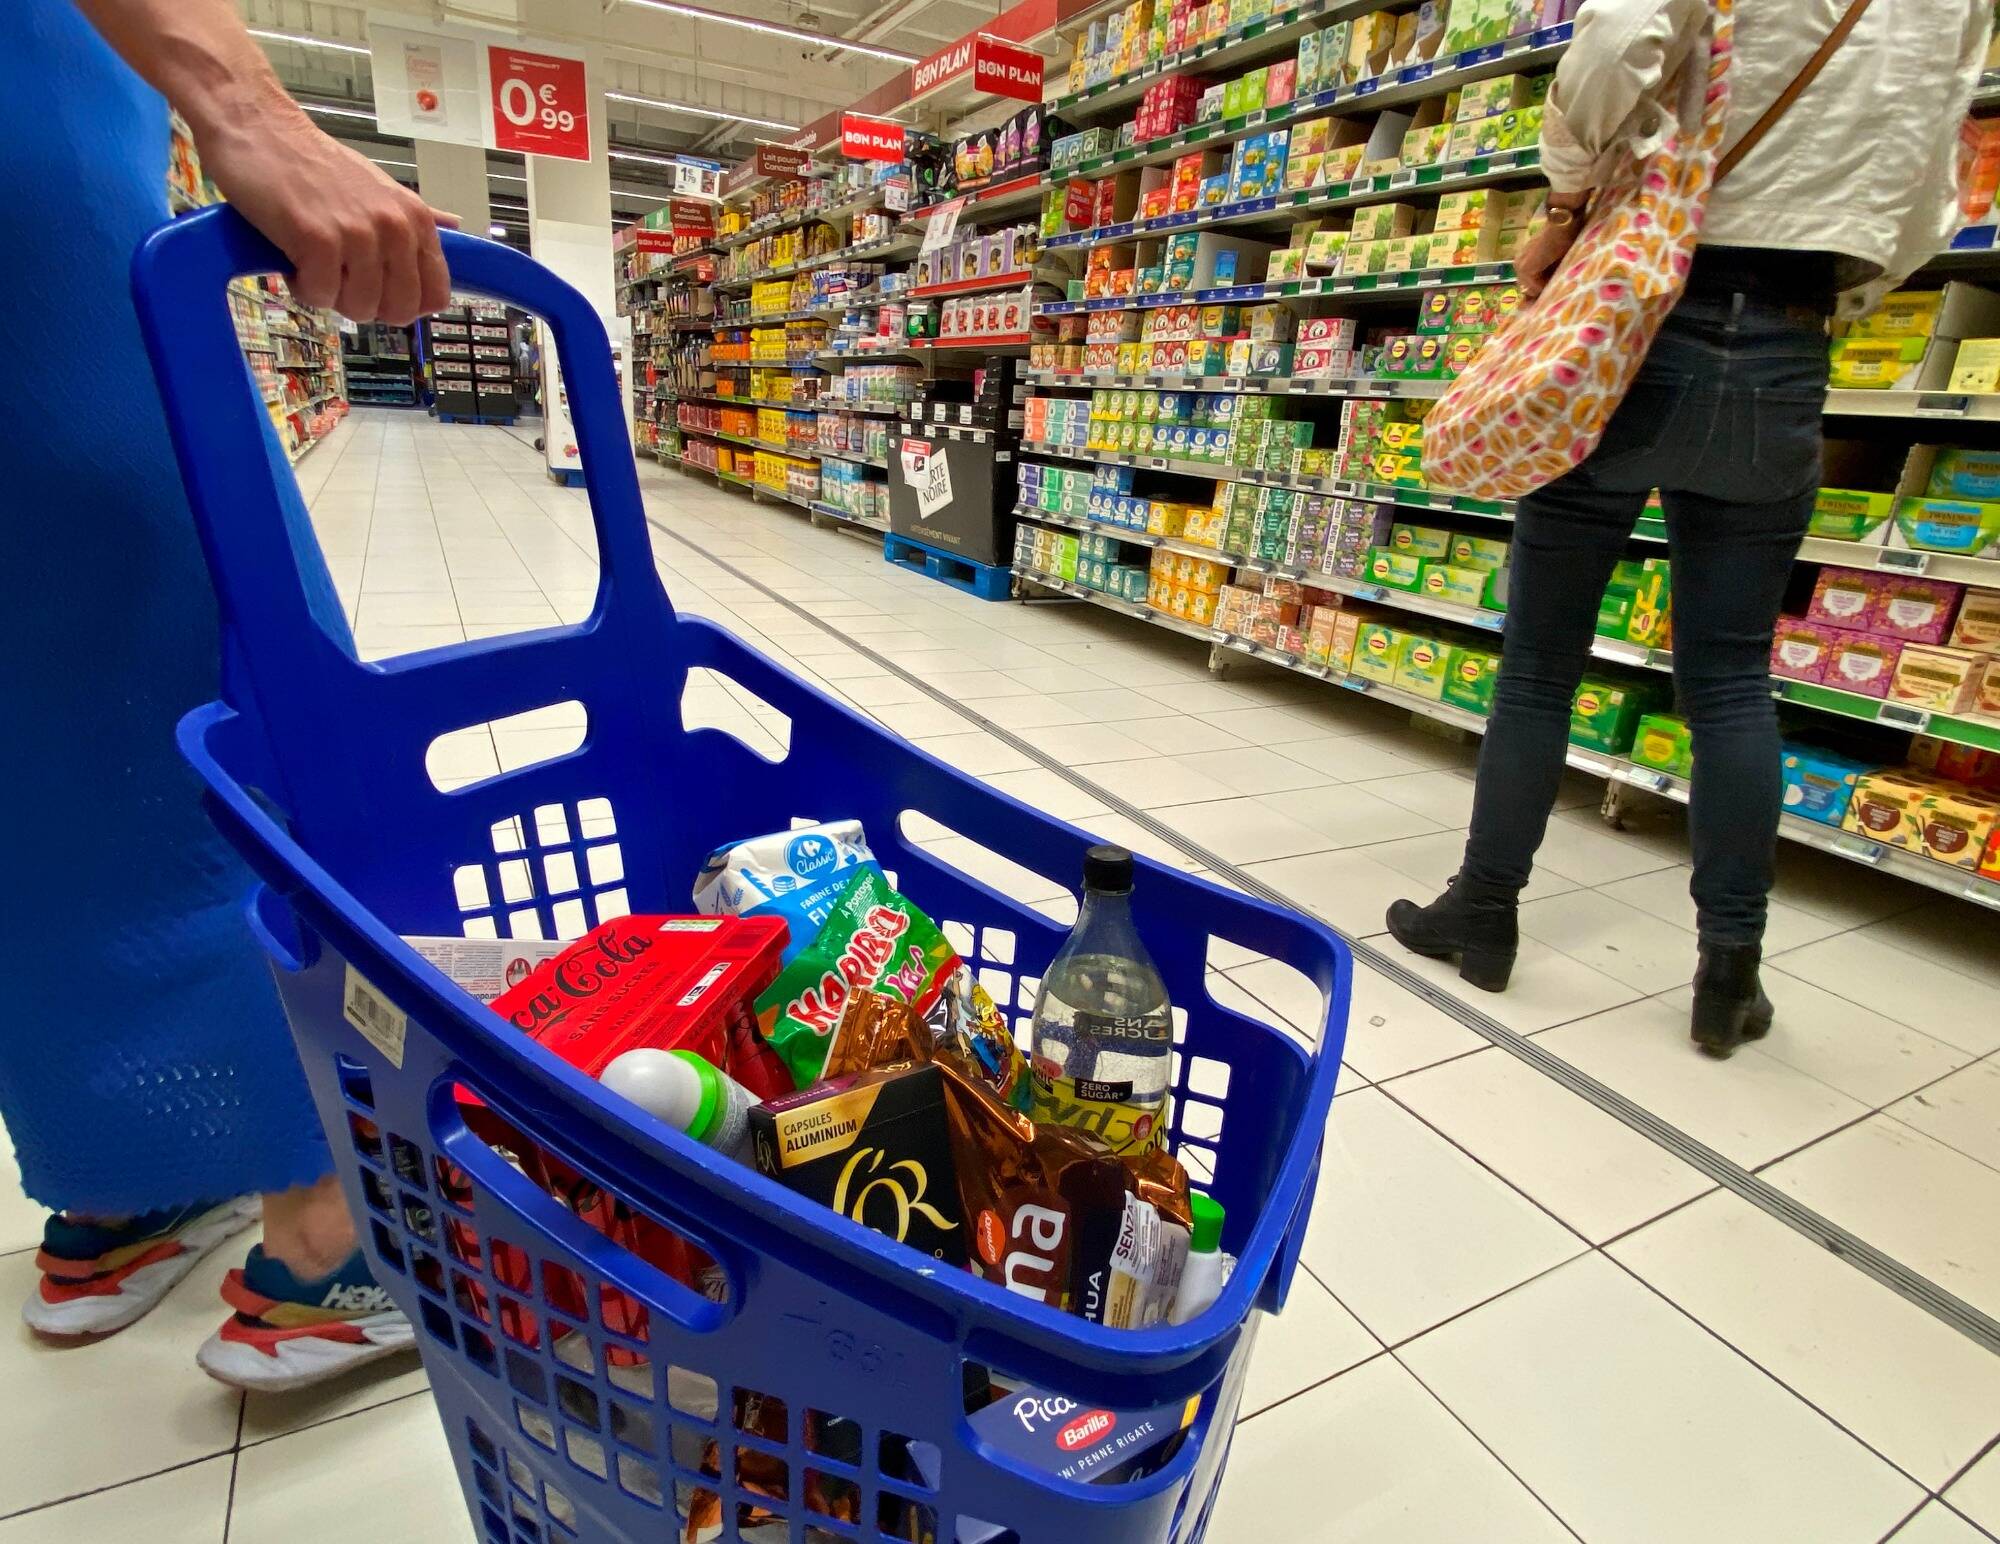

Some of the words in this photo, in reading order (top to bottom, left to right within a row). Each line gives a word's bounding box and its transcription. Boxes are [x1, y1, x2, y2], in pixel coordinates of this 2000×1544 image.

[915, 61, 939, 90] BON
[940, 43, 970, 77] PLAN
[978, 59, 1005, 79] BON
[1009, 66, 1040, 86] PLAN
[501, 79, 536, 126] 0
[539, 84, 557, 106] €
[541, 108, 574, 132] 99
[845, 131, 869, 145] BON
[873, 136, 901, 151] PLAN
[929, 462, 946, 482] RTE
[922, 478, 948, 503] NOIRE
[800, 887, 832, 910] FARINE
[832, 880, 846, 893] DE
[786, 904, 910, 1036] HARIBO
[569, 1004, 611, 1041] SANS
[611, 961, 657, 1003] SUCRES
[1081, 1081, 1111, 1091] ZERO
[783, 1112, 832, 1136] CAPSULES
[786, 1118, 857, 1153] ALUMINIUM
[1117, 1204, 1135, 1260] SENZA
[1085, 1271, 1102, 1323] HUA
[1063, 1413, 1110, 1447] Barilla
[1057, 1466, 1076, 1480] NI
[1077, 1443, 1116, 1471] PENNE
[1117, 1420, 1155, 1449] RIGATE
